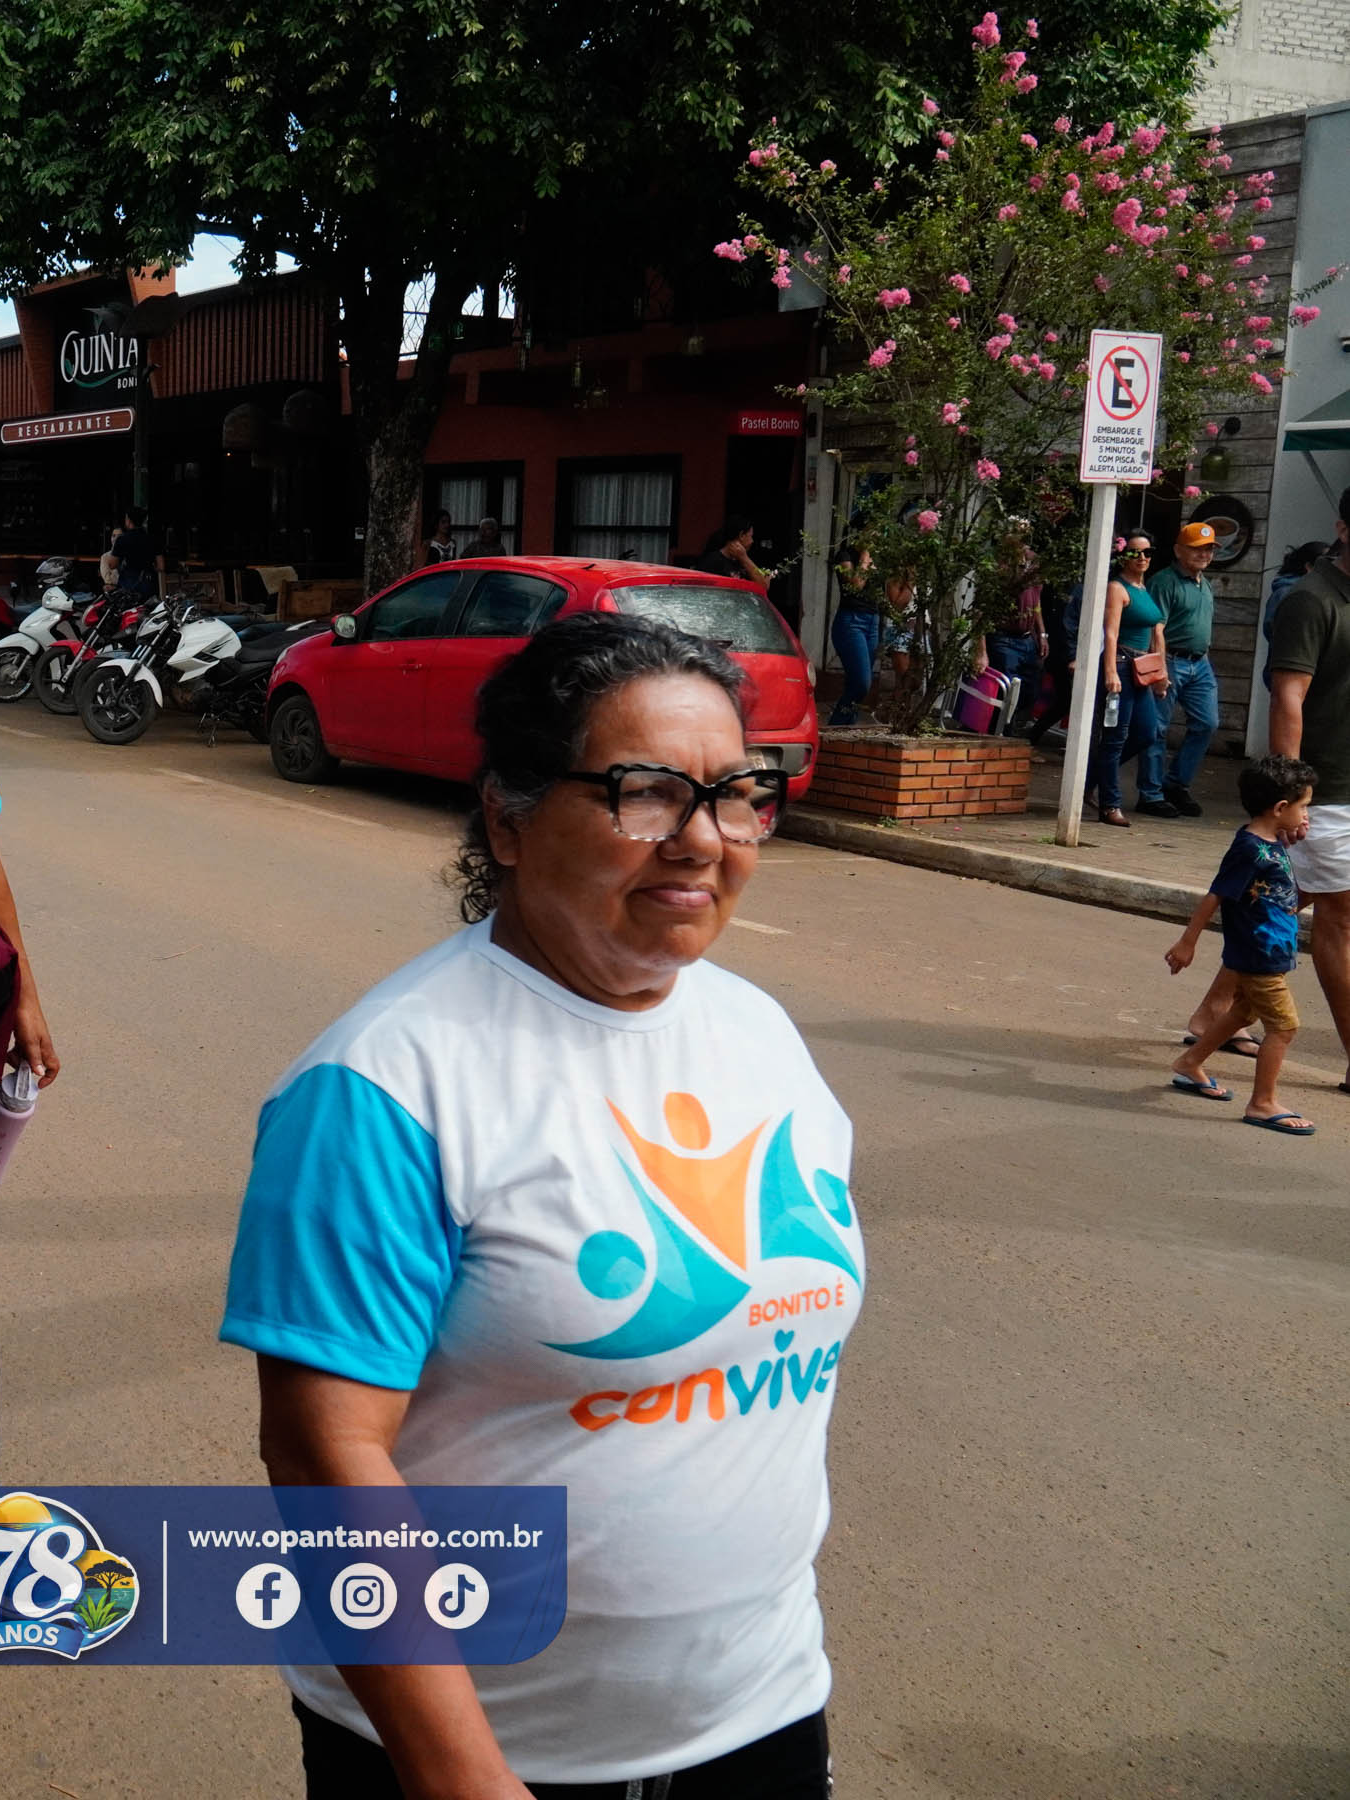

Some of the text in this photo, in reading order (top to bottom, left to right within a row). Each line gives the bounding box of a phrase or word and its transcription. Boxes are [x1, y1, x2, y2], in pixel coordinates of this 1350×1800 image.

[18, 416, 111, 438] RESTAURANTE
[741, 417, 800, 429] Pastel Bonito
[1096, 425, 1143, 436] EMBARQUE E
[1092, 435, 1145, 446] DESEMBARQUE
[1098, 445, 1137, 455] 5 MINUTOS
[1097, 455, 1114, 463] COM
[1115, 455, 1136, 464] PISCA
[1088, 464, 1144, 475] ALERTA LIGADO
[748, 1276, 845, 1327] BONITO É
